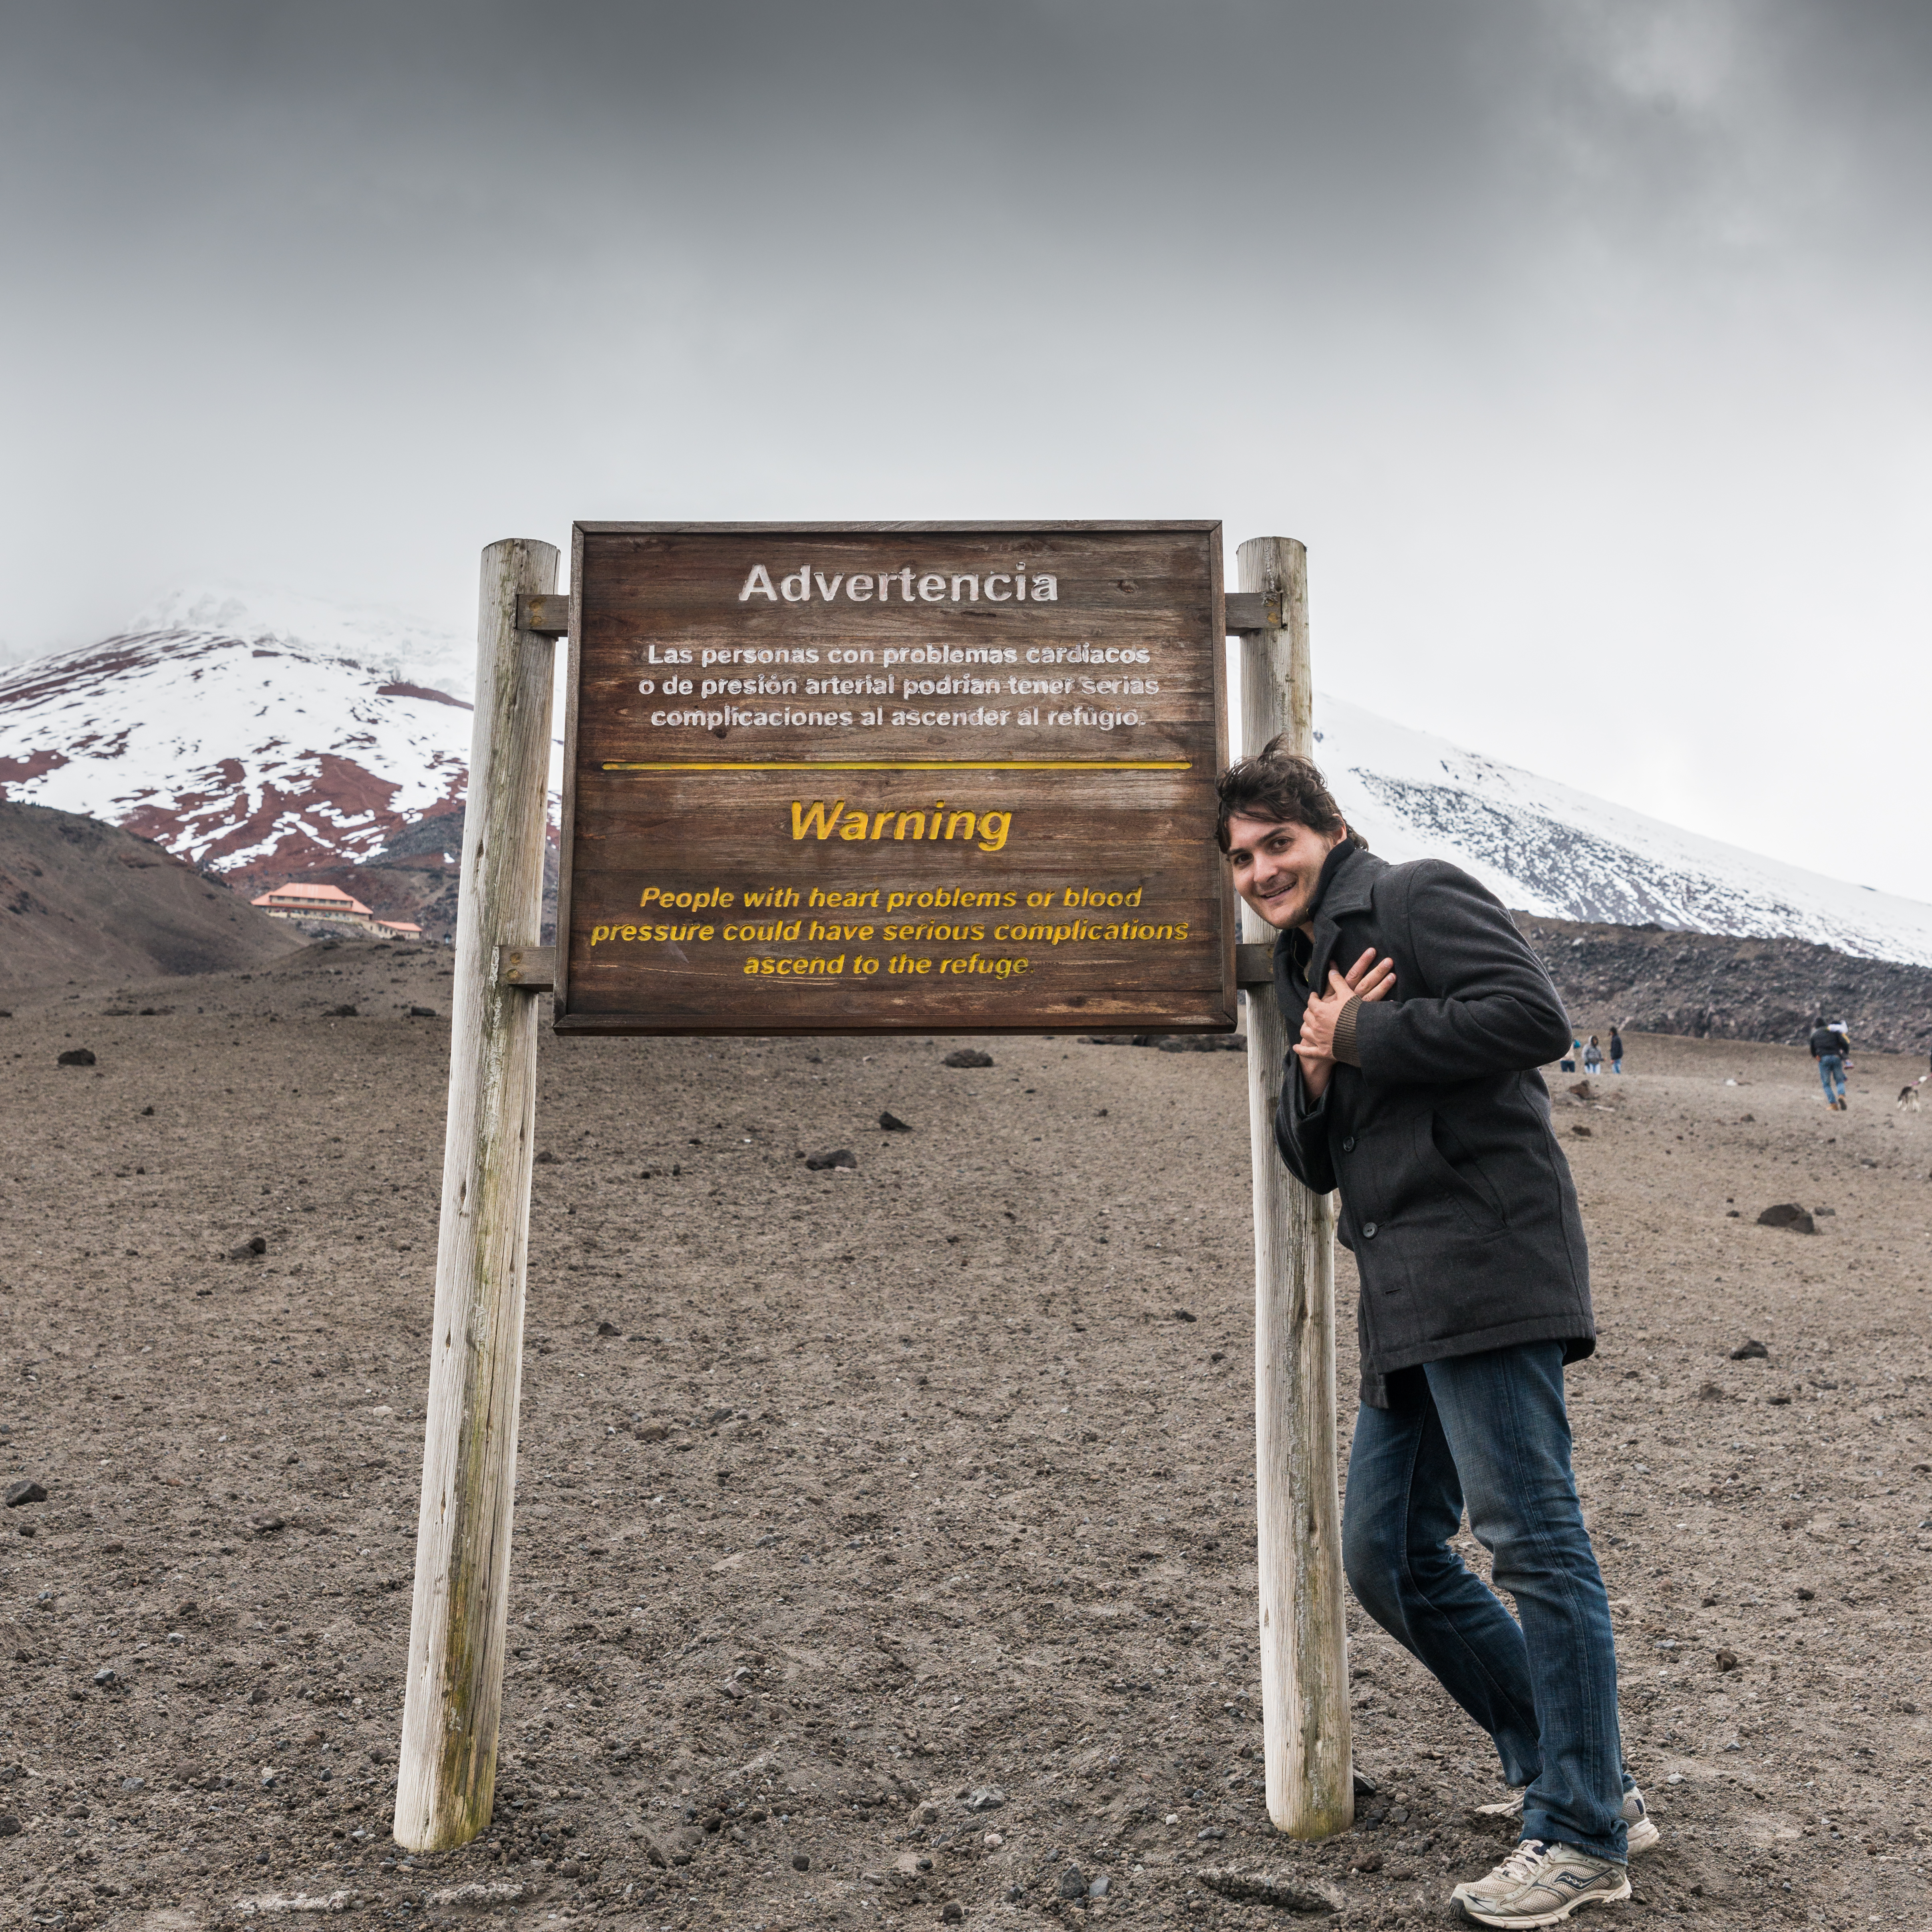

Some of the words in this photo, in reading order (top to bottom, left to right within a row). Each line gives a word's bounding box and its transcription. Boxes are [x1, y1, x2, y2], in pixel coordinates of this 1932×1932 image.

[739, 562, 1058, 601] Advertencia
[648, 645, 693, 664] Las
[702, 648, 819, 667] personas
[828, 648, 874, 663] con
[883, 643, 1018, 668] problemas
[639, 679, 654, 694] o
[662, 675, 693, 694] de
[805, 674, 894, 694] arterial
[1008, 675, 1075, 694] tener
[1082, 675, 1159, 694] serias
[651, 704, 853, 730] complicaciones
[861, 706, 883, 725] al
[891, 706, 1010, 725] ascender
[1017, 706, 1038, 725] al
[791, 799, 1012, 851] Warning
[640, 886, 734, 912] People
[744, 886, 799, 907] with
[809, 886, 880, 907] heart
[886, 886, 1017, 912] problems
[1026, 890, 1056, 907] or
[1063, 886, 1143, 907] blood
[591, 924, 714, 946] pressure
[723, 920, 801, 941] could
[808, 920, 874, 940] have
[883, 919, 985, 940] serious
[994, 919, 1189, 945] complications
[743, 953, 846, 974] ascend
[853, 955, 879, 974] to
[888, 953, 932, 974] the
